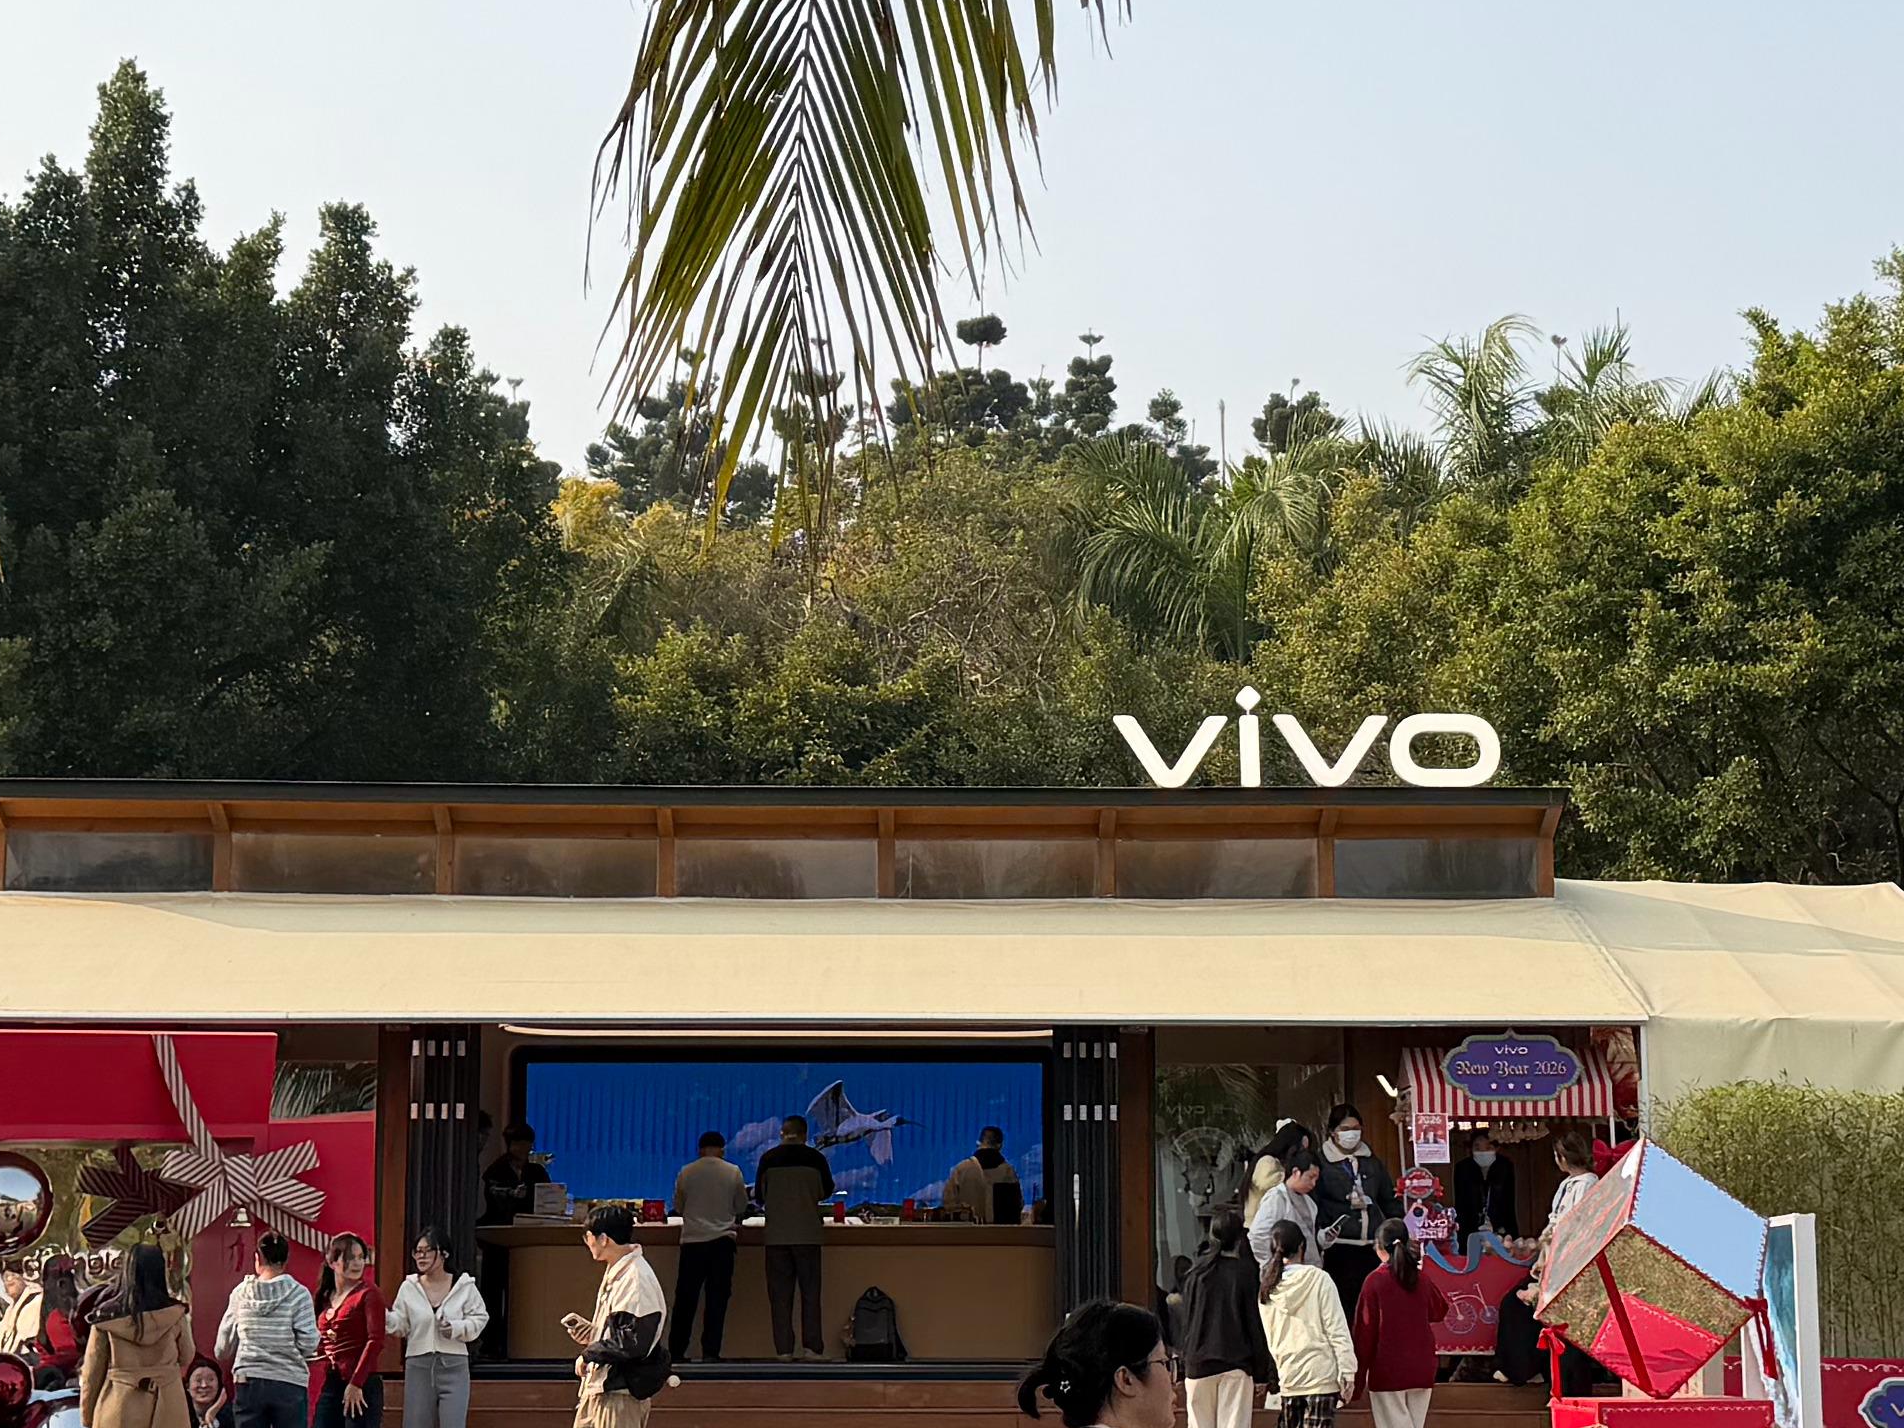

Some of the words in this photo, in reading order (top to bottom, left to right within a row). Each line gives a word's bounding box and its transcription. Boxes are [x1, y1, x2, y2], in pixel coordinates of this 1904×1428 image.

[1113, 685, 1500, 788] vivo
[1494, 1044, 1529, 1055] vivo
[1456, 1061, 1490, 1075] New
[1494, 1060, 1530, 1077] Year
[1534, 1061, 1567, 1075] 2026
